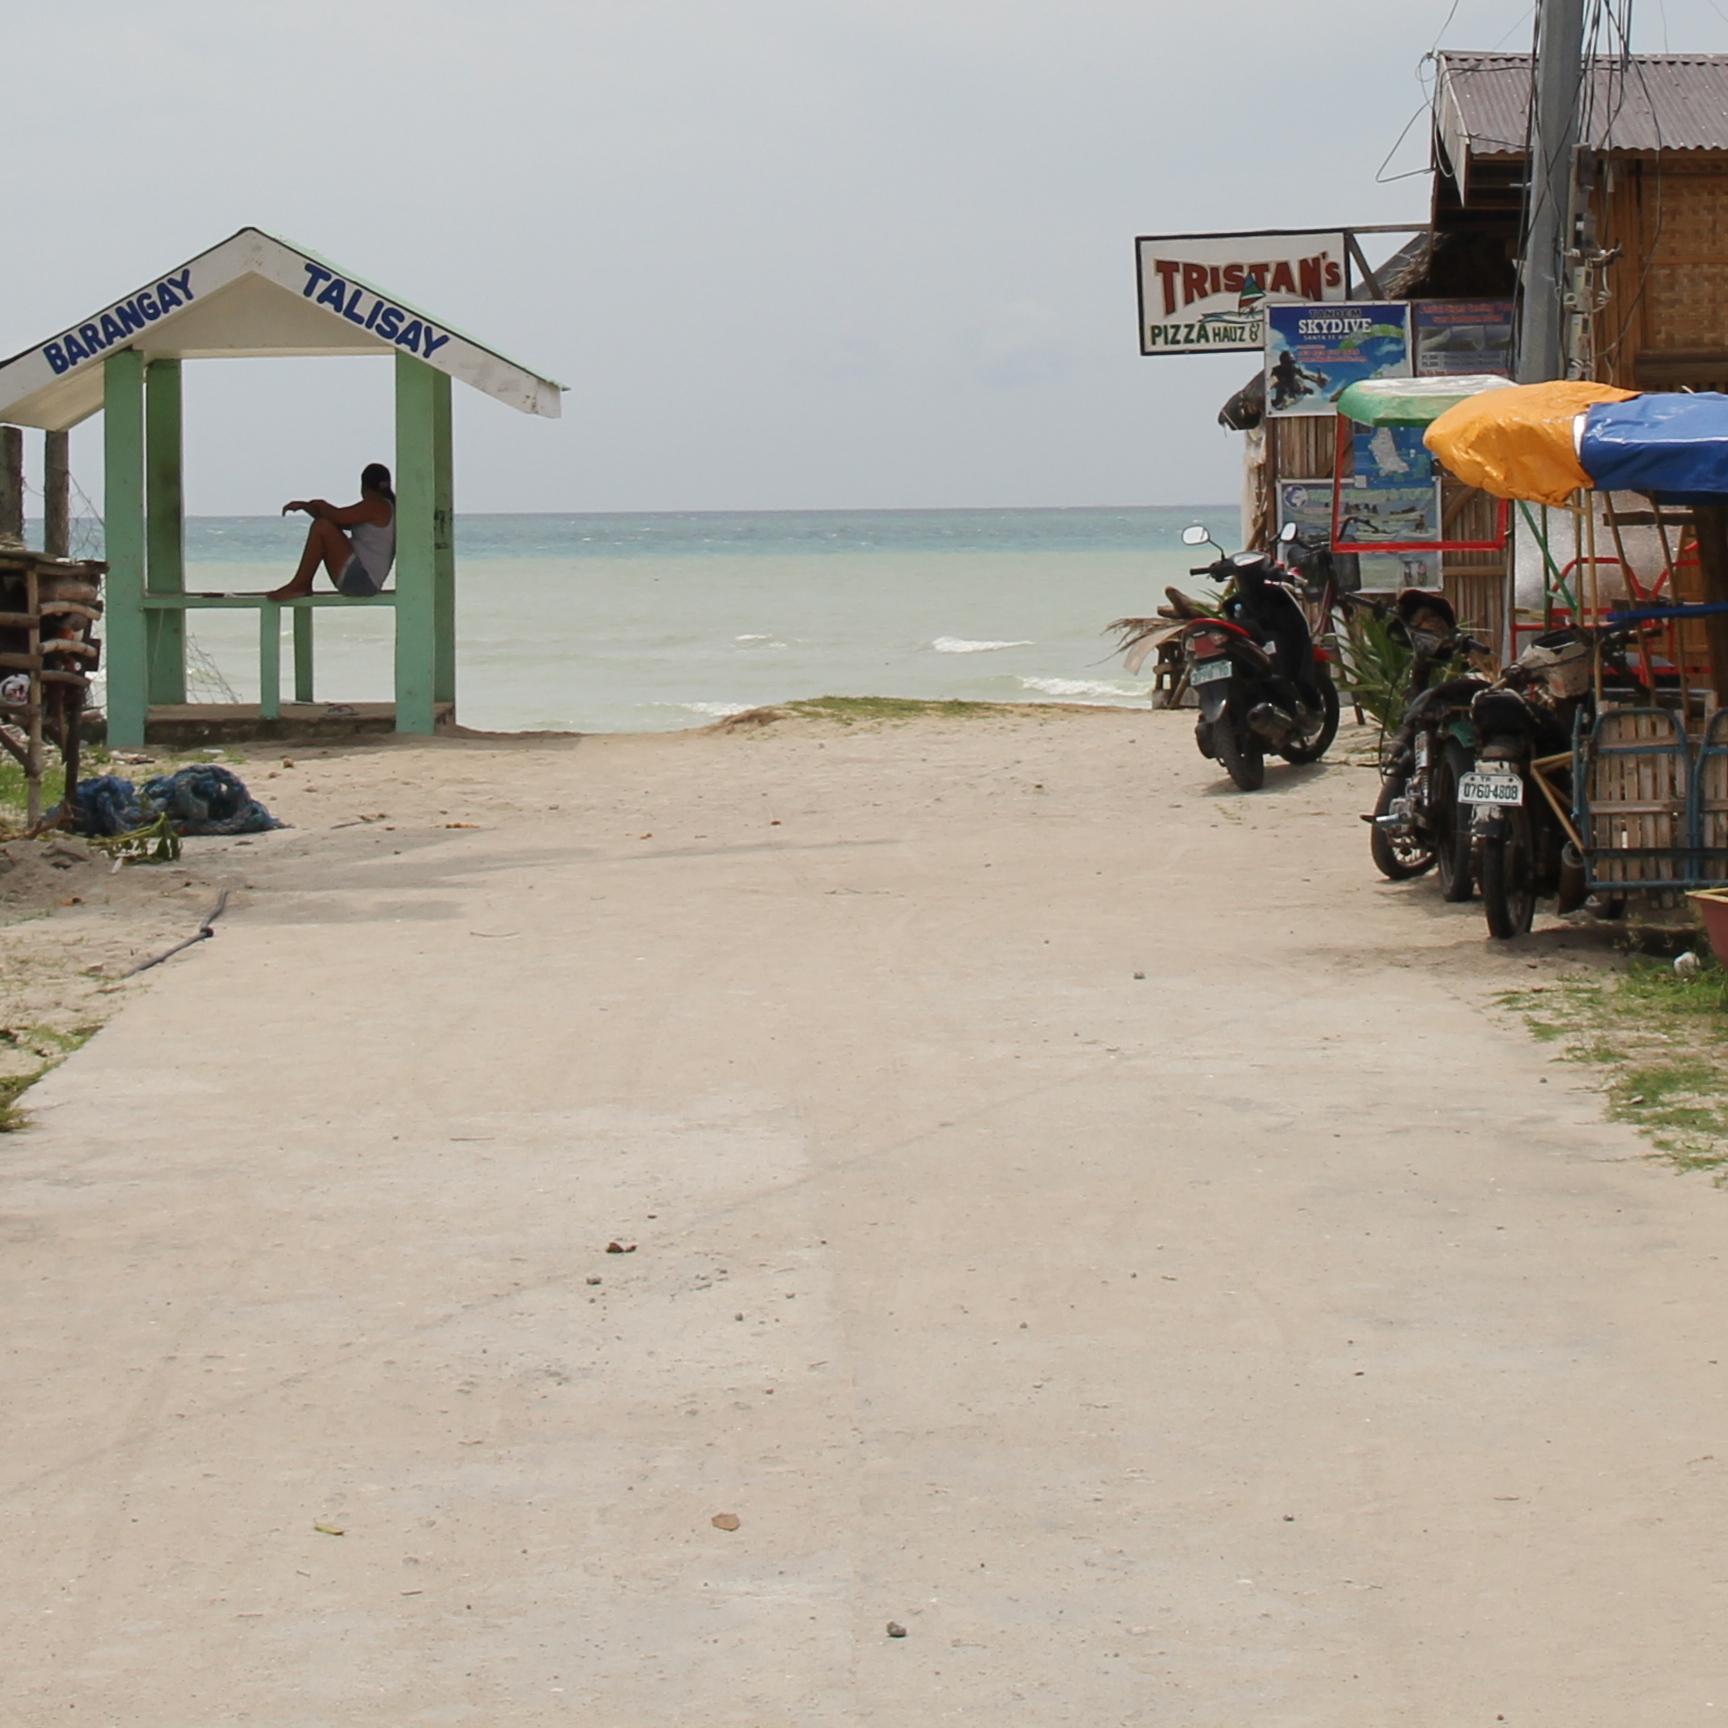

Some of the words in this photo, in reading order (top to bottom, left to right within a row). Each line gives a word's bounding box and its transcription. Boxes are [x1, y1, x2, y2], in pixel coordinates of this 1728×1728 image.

[43, 268, 195, 374] BARANGAY
[303, 262, 450, 359] TALISAY
[1298, 318, 1372, 334] SKYDIVE
[1150, 322, 1210, 346] PIZZA
[1212, 325, 1246, 343] HAUZ
